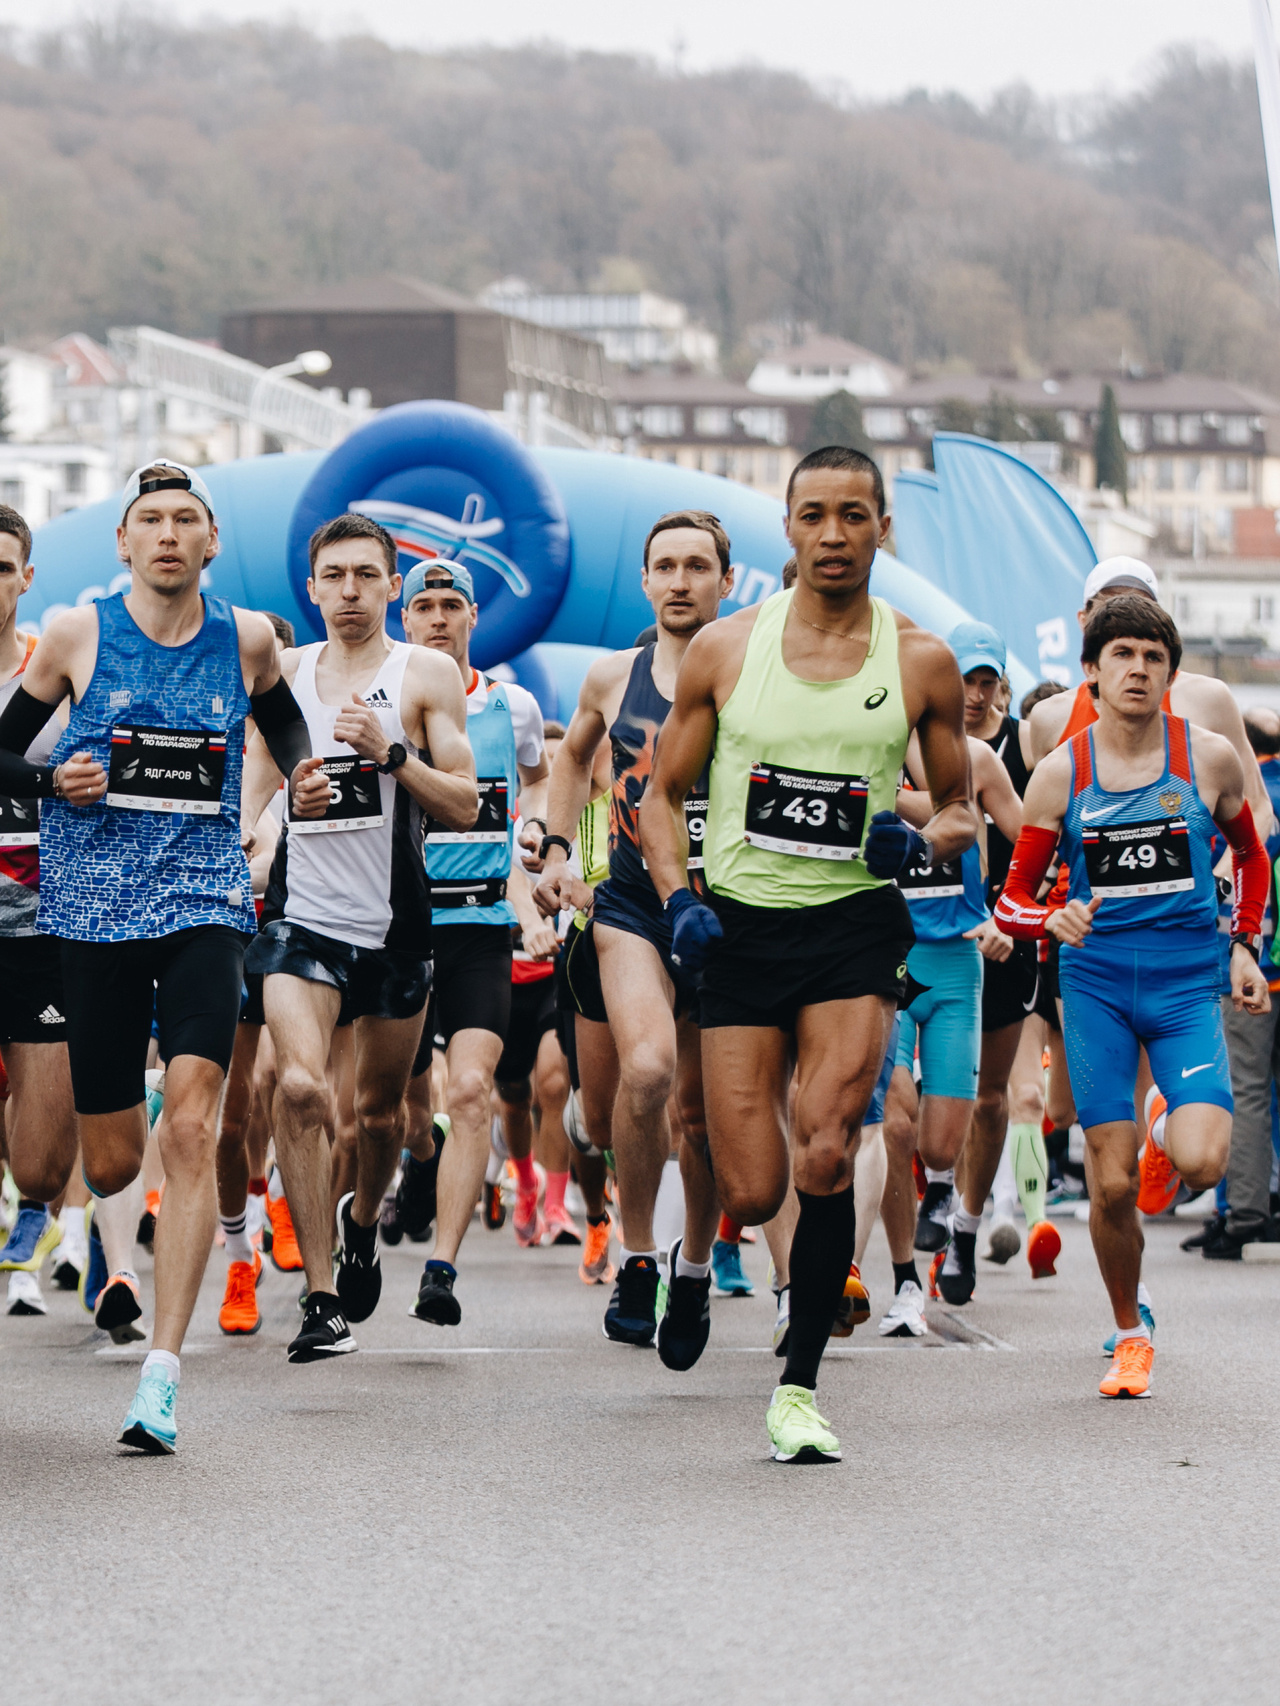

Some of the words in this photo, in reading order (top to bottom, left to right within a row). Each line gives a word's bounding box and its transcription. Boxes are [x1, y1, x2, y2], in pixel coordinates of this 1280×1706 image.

[137, 733, 179, 741] ЧЕМПИОНАТ
[155, 740, 200, 749] МАРАФОНУ
[144, 767, 192, 780] ЯДГАРОВ
[774, 773, 817, 783] ЧЕМПИОНАТ
[792, 782, 840, 793] МАРАФОНУ
[782, 797, 828, 826] 43
[688, 817, 706, 841] 9
[1120, 831, 1162, 841] МАРАФОНУ
[1117, 844, 1157, 870] 49
